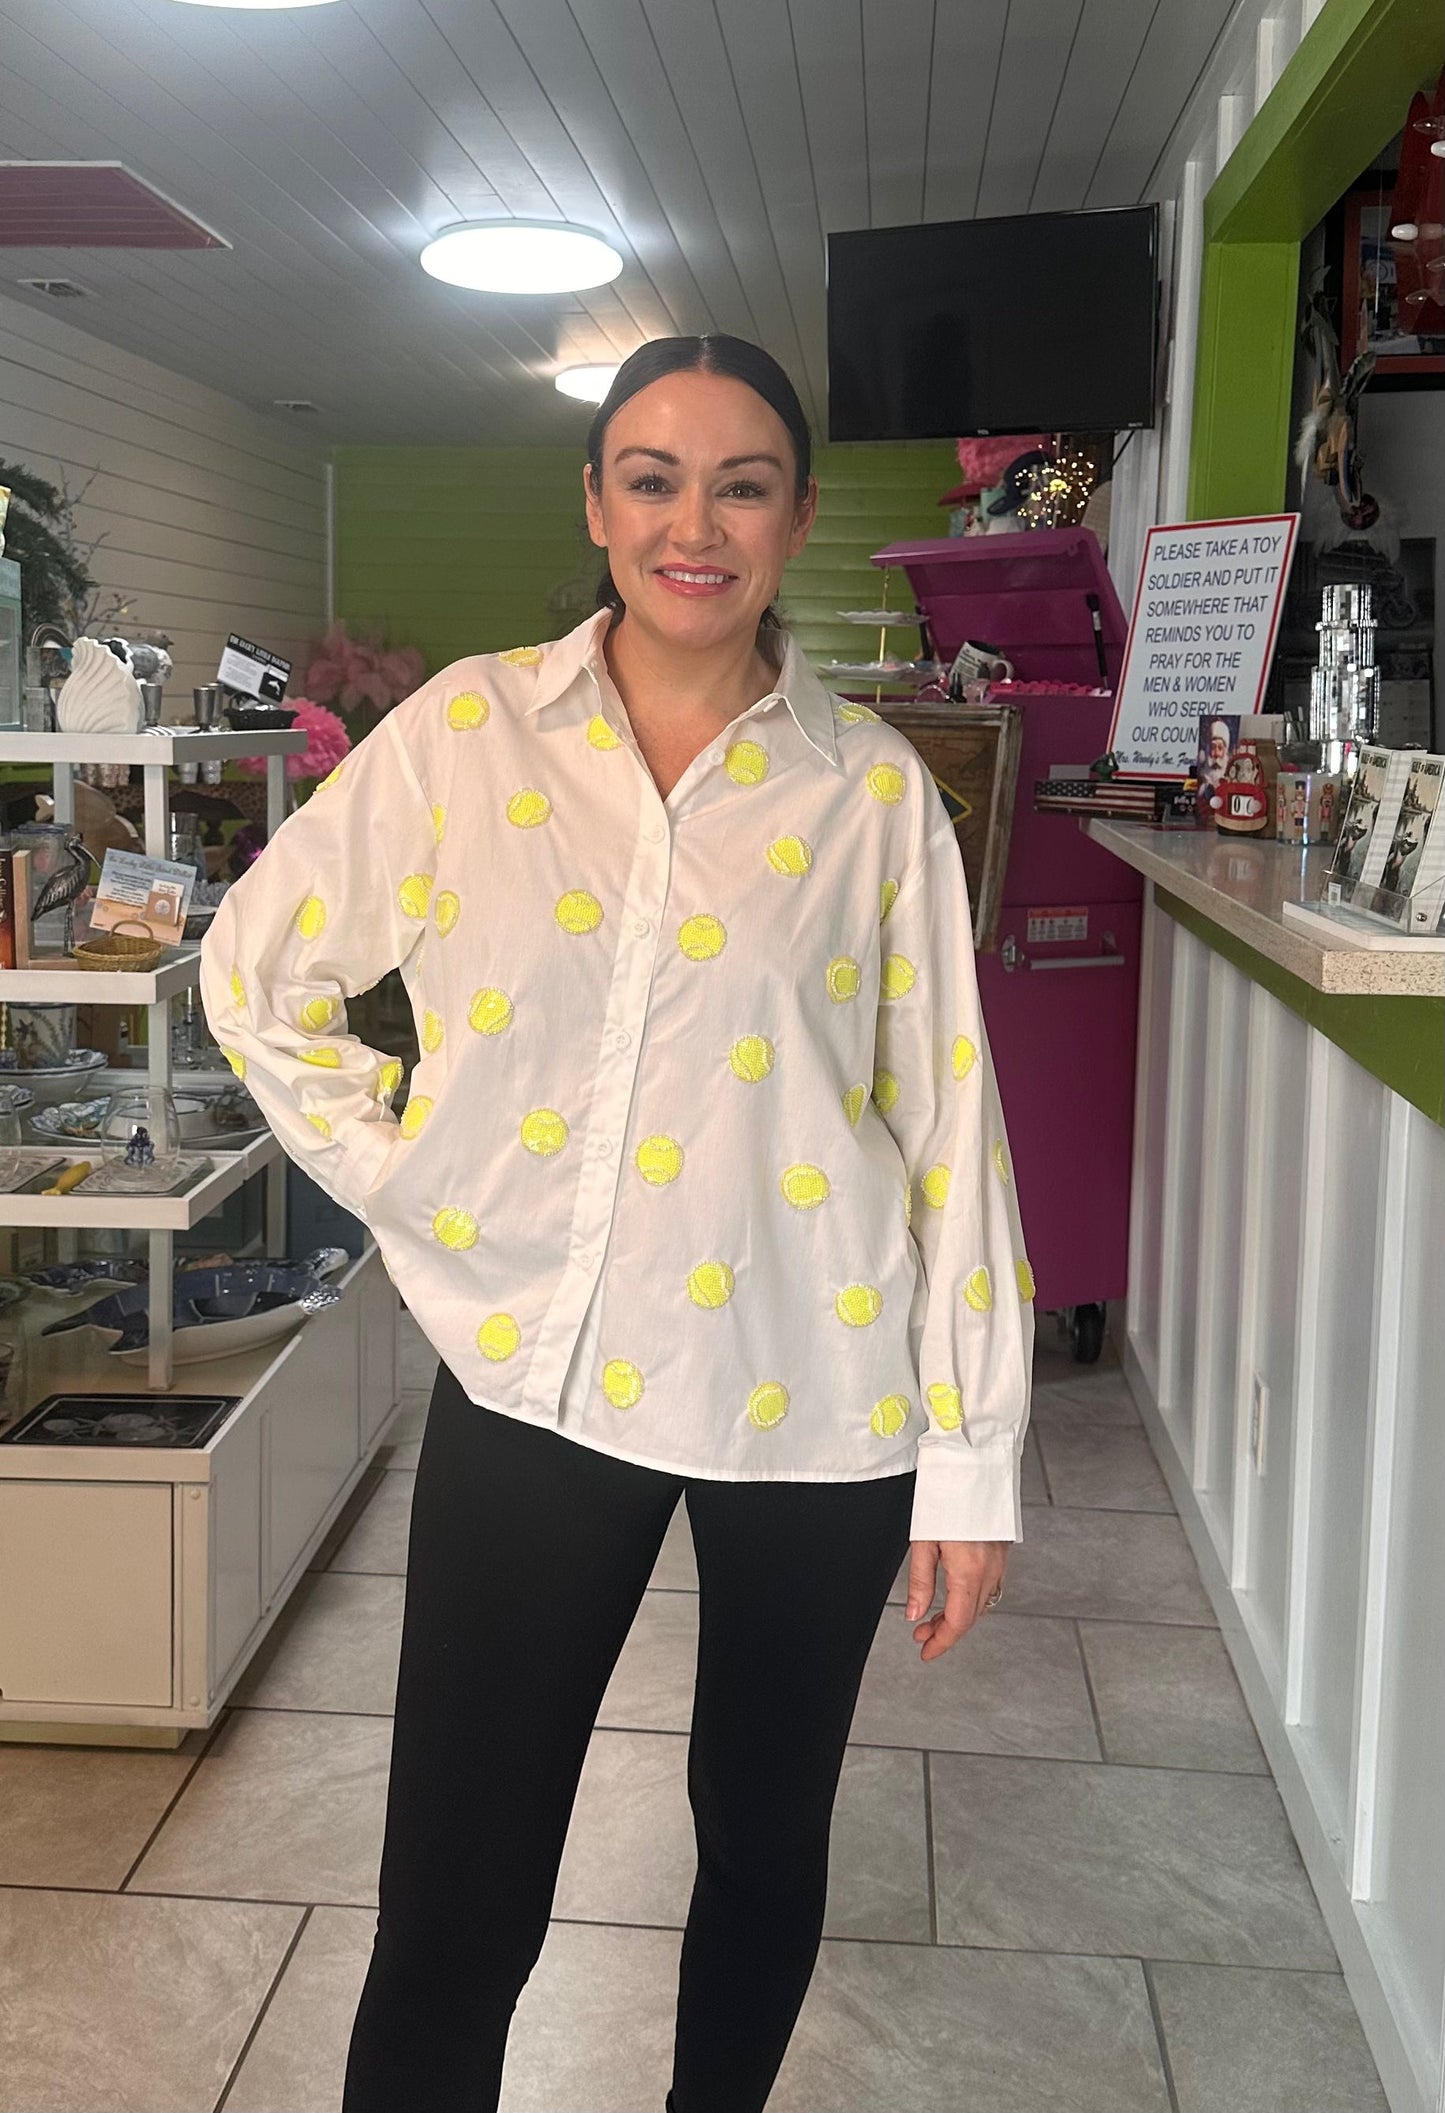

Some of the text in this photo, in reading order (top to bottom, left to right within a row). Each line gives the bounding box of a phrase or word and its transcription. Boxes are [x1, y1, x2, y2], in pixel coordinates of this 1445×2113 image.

[1153, 536, 1282, 561] PLEASE TAKE A TOY
[1148, 566, 1279, 591] SOLDIER AND PUT IT
[1146, 595, 1268, 617] SOMEWHERE THAT
[1145, 623, 1256, 643] REMINDS YOU TO
[1149, 651, 1242, 669] PRAY FOR THE
[1143, 675, 1236, 692] MEN & WOMEN
[1148, 700, 1225, 717] WHO SERVE
[1132, 726, 1198, 743] OUR COUN
